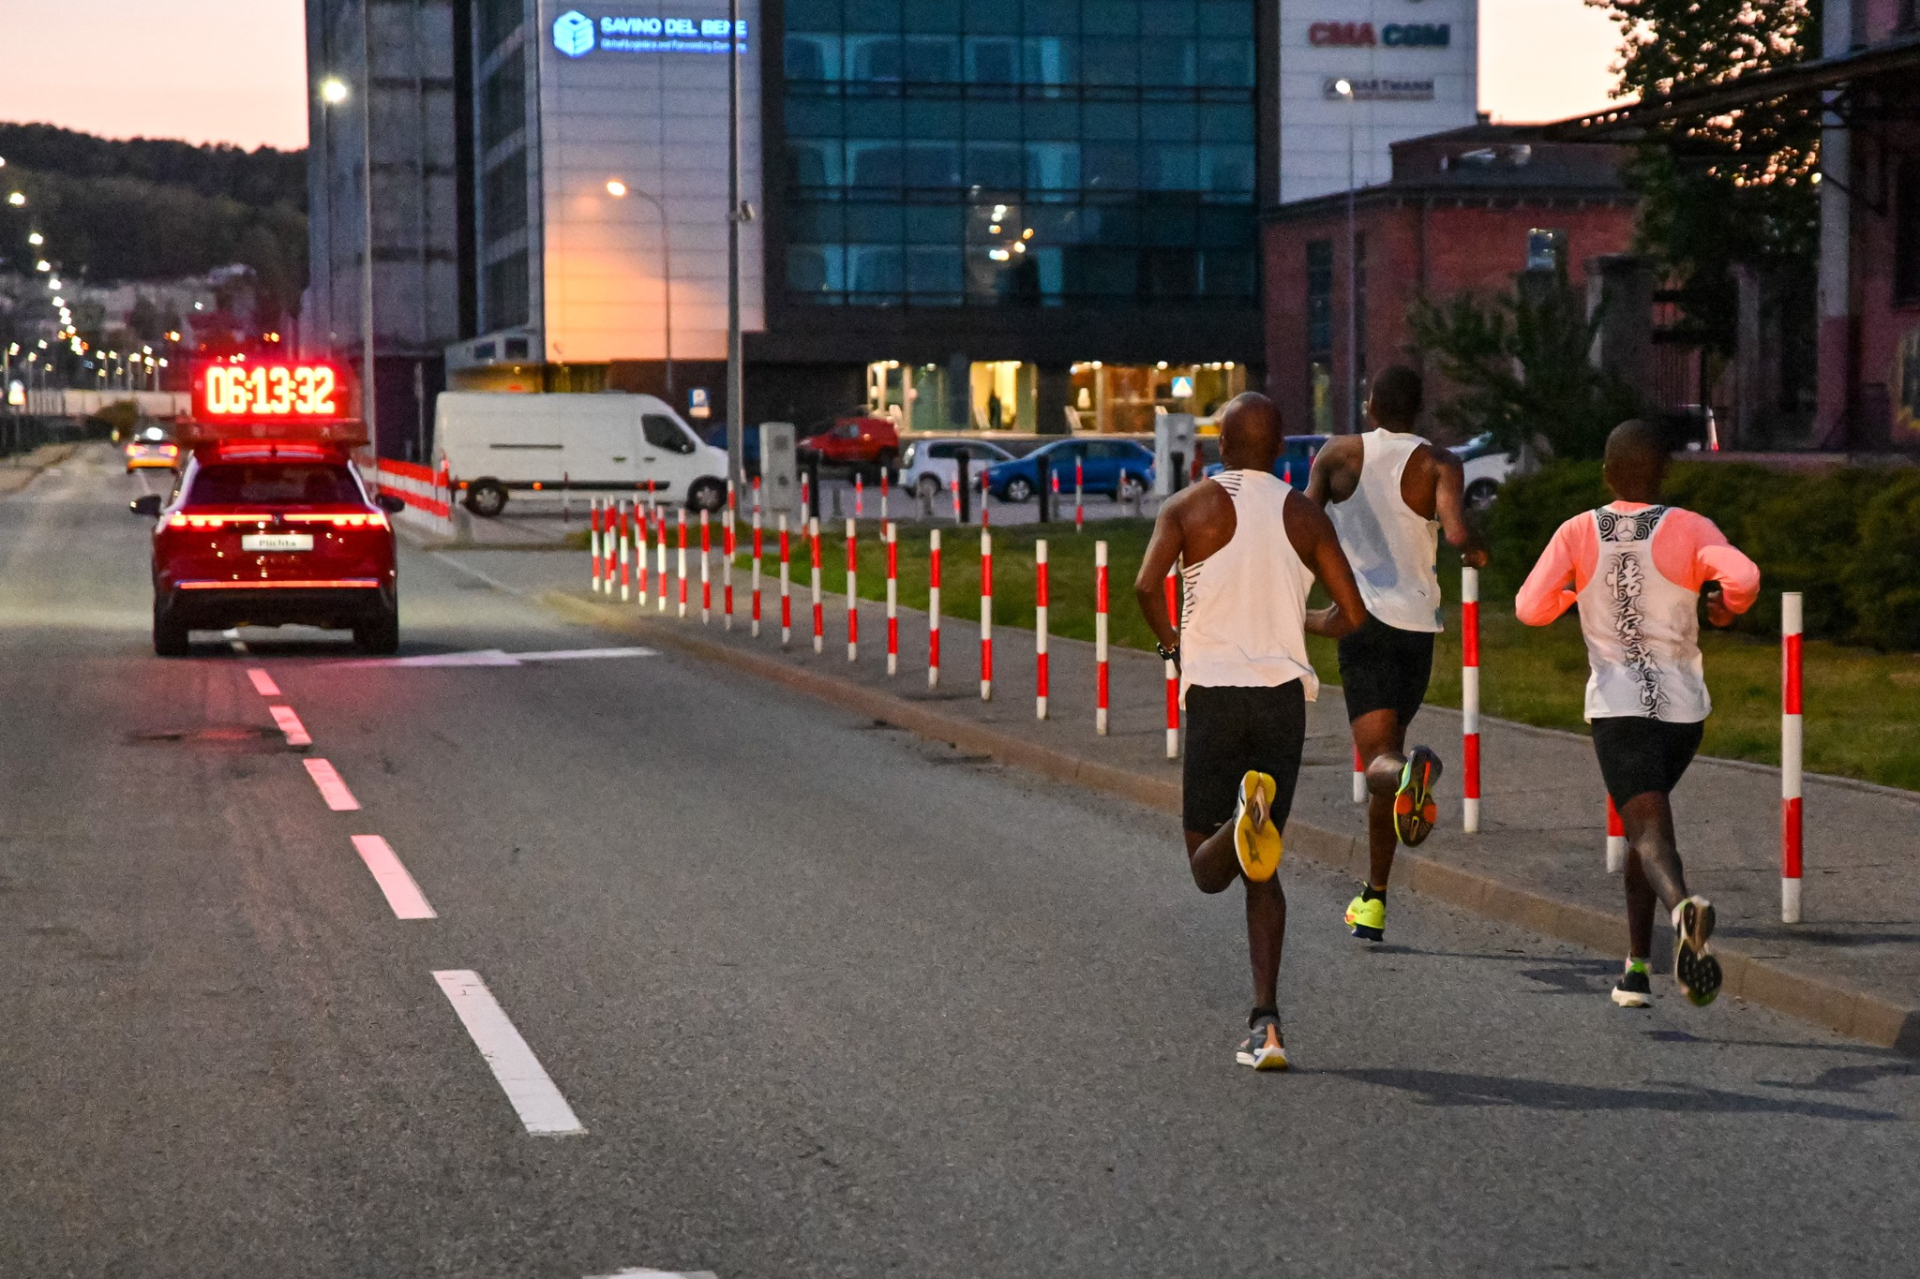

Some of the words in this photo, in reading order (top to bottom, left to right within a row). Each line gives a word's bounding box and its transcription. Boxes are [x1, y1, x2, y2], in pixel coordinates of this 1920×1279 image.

[600, 17, 663, 36] SAVINO
[664, 18, 699, 37] DEL
[1308, 22, 1376, 46] CMA
[207, 367, 335, 414] 06:13:32
